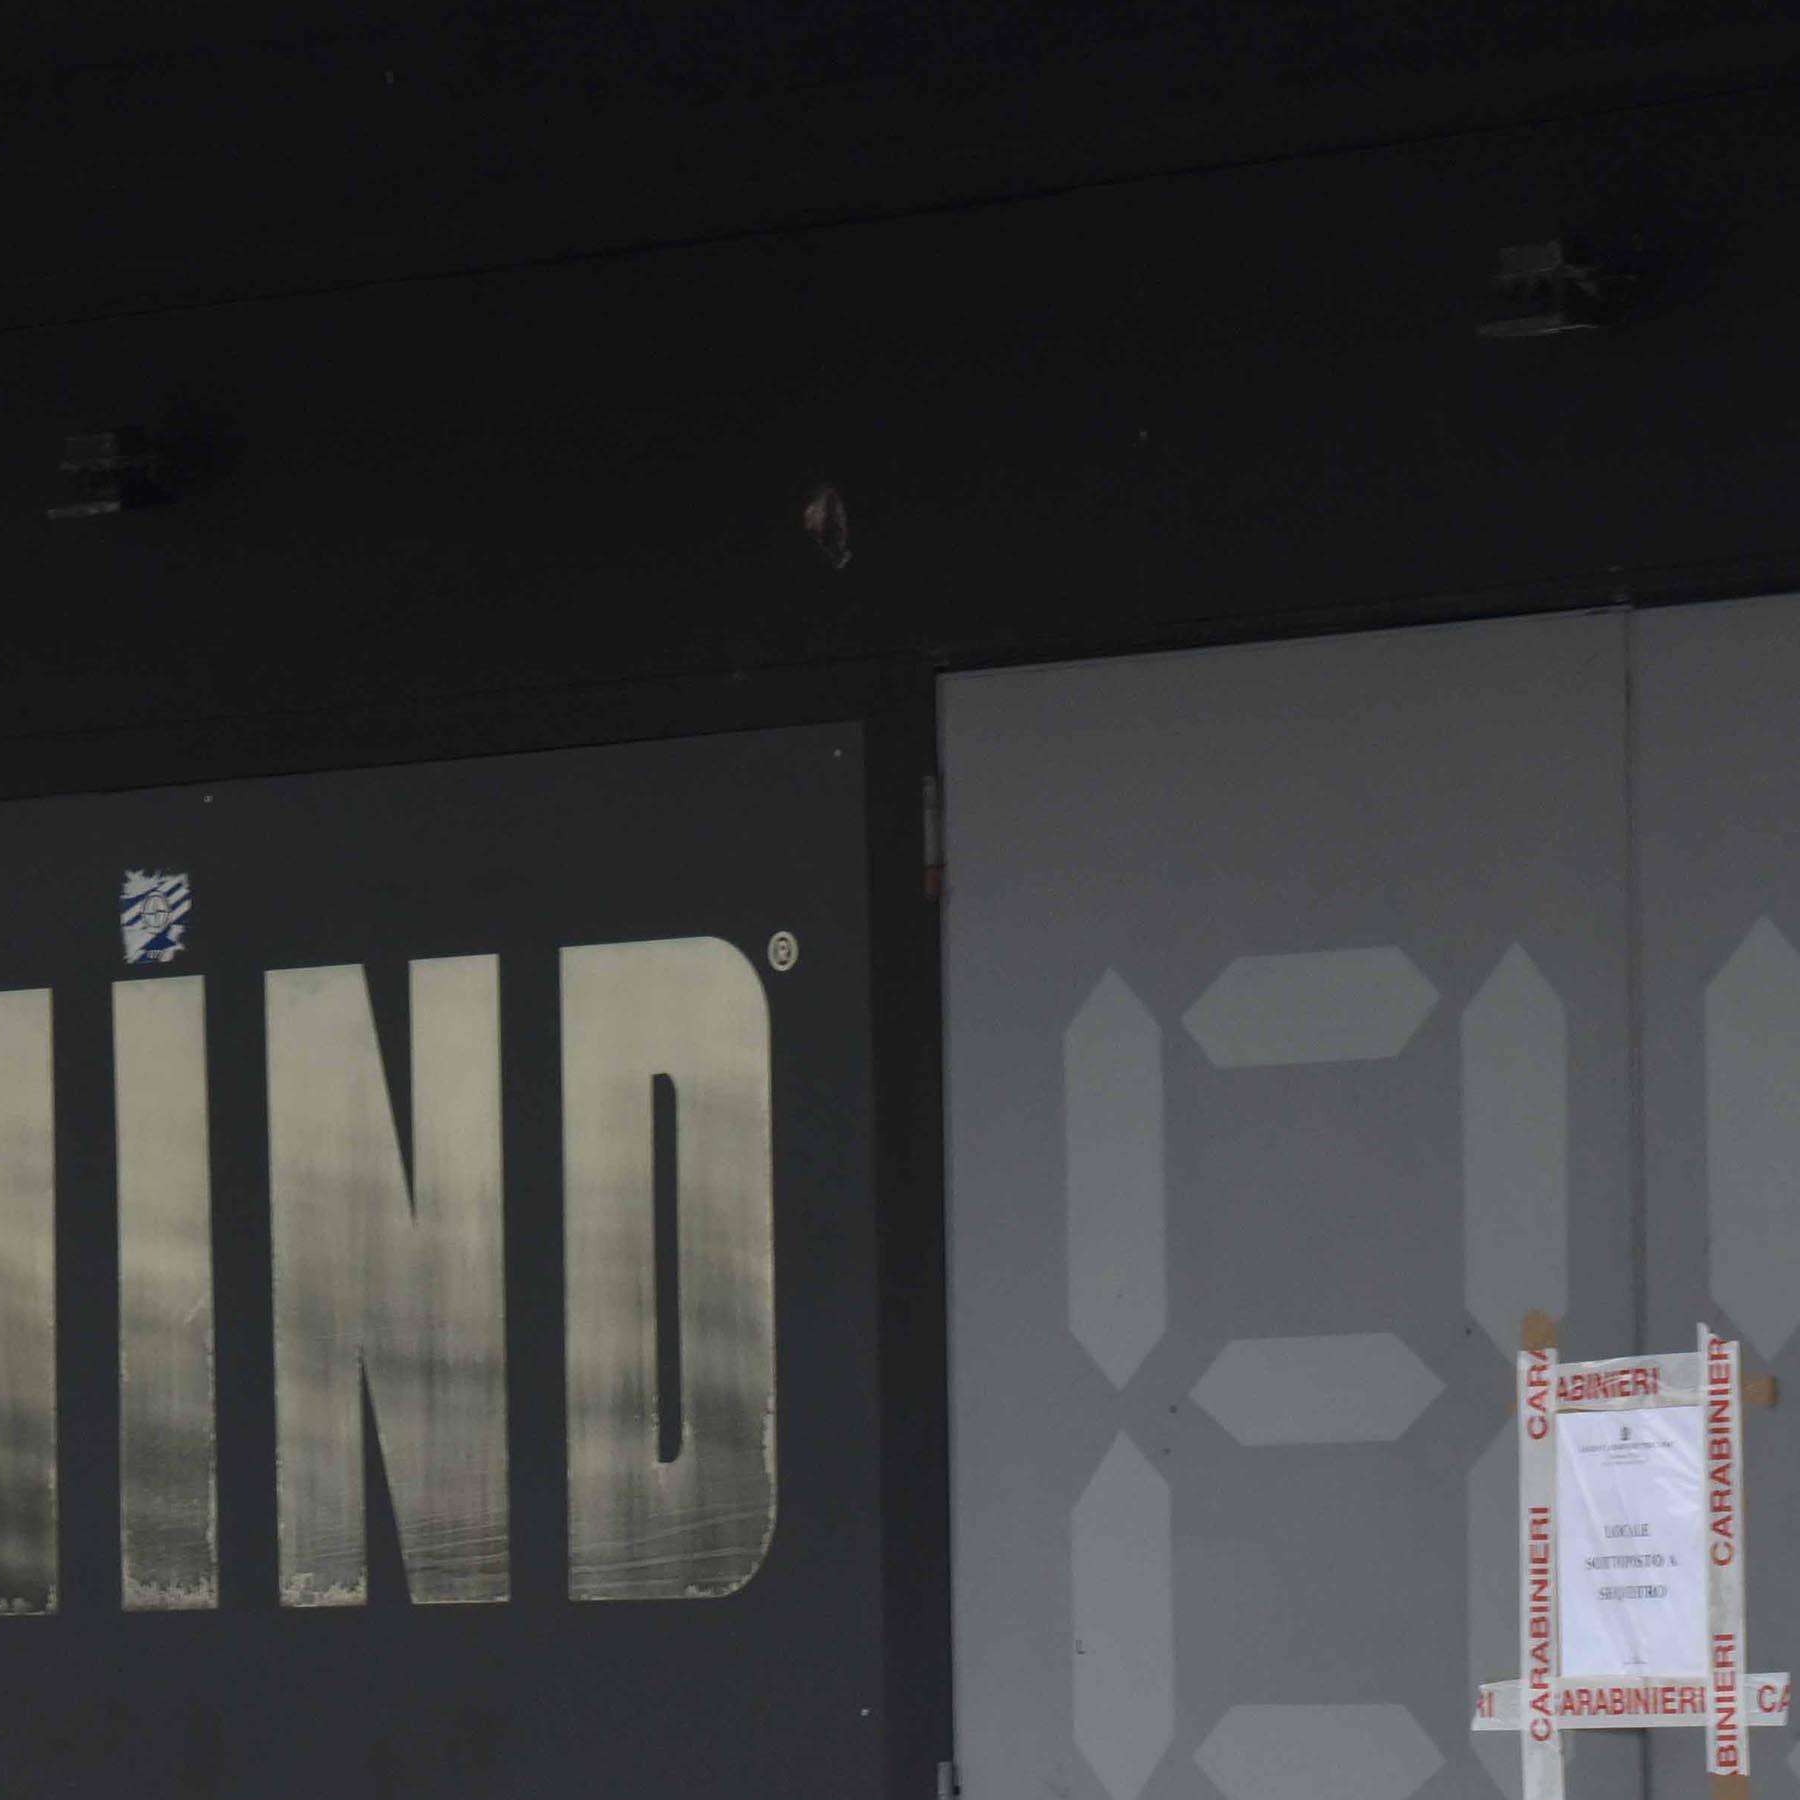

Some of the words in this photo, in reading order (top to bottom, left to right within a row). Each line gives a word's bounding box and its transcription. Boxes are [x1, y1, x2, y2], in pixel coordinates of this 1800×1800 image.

[1527, 1506, 1553, 1742] CARABINIERI
[1555, 1686, 1707, 1716] ARABINIERI
[1713, 1632, 1739, 1775] BINIERI
